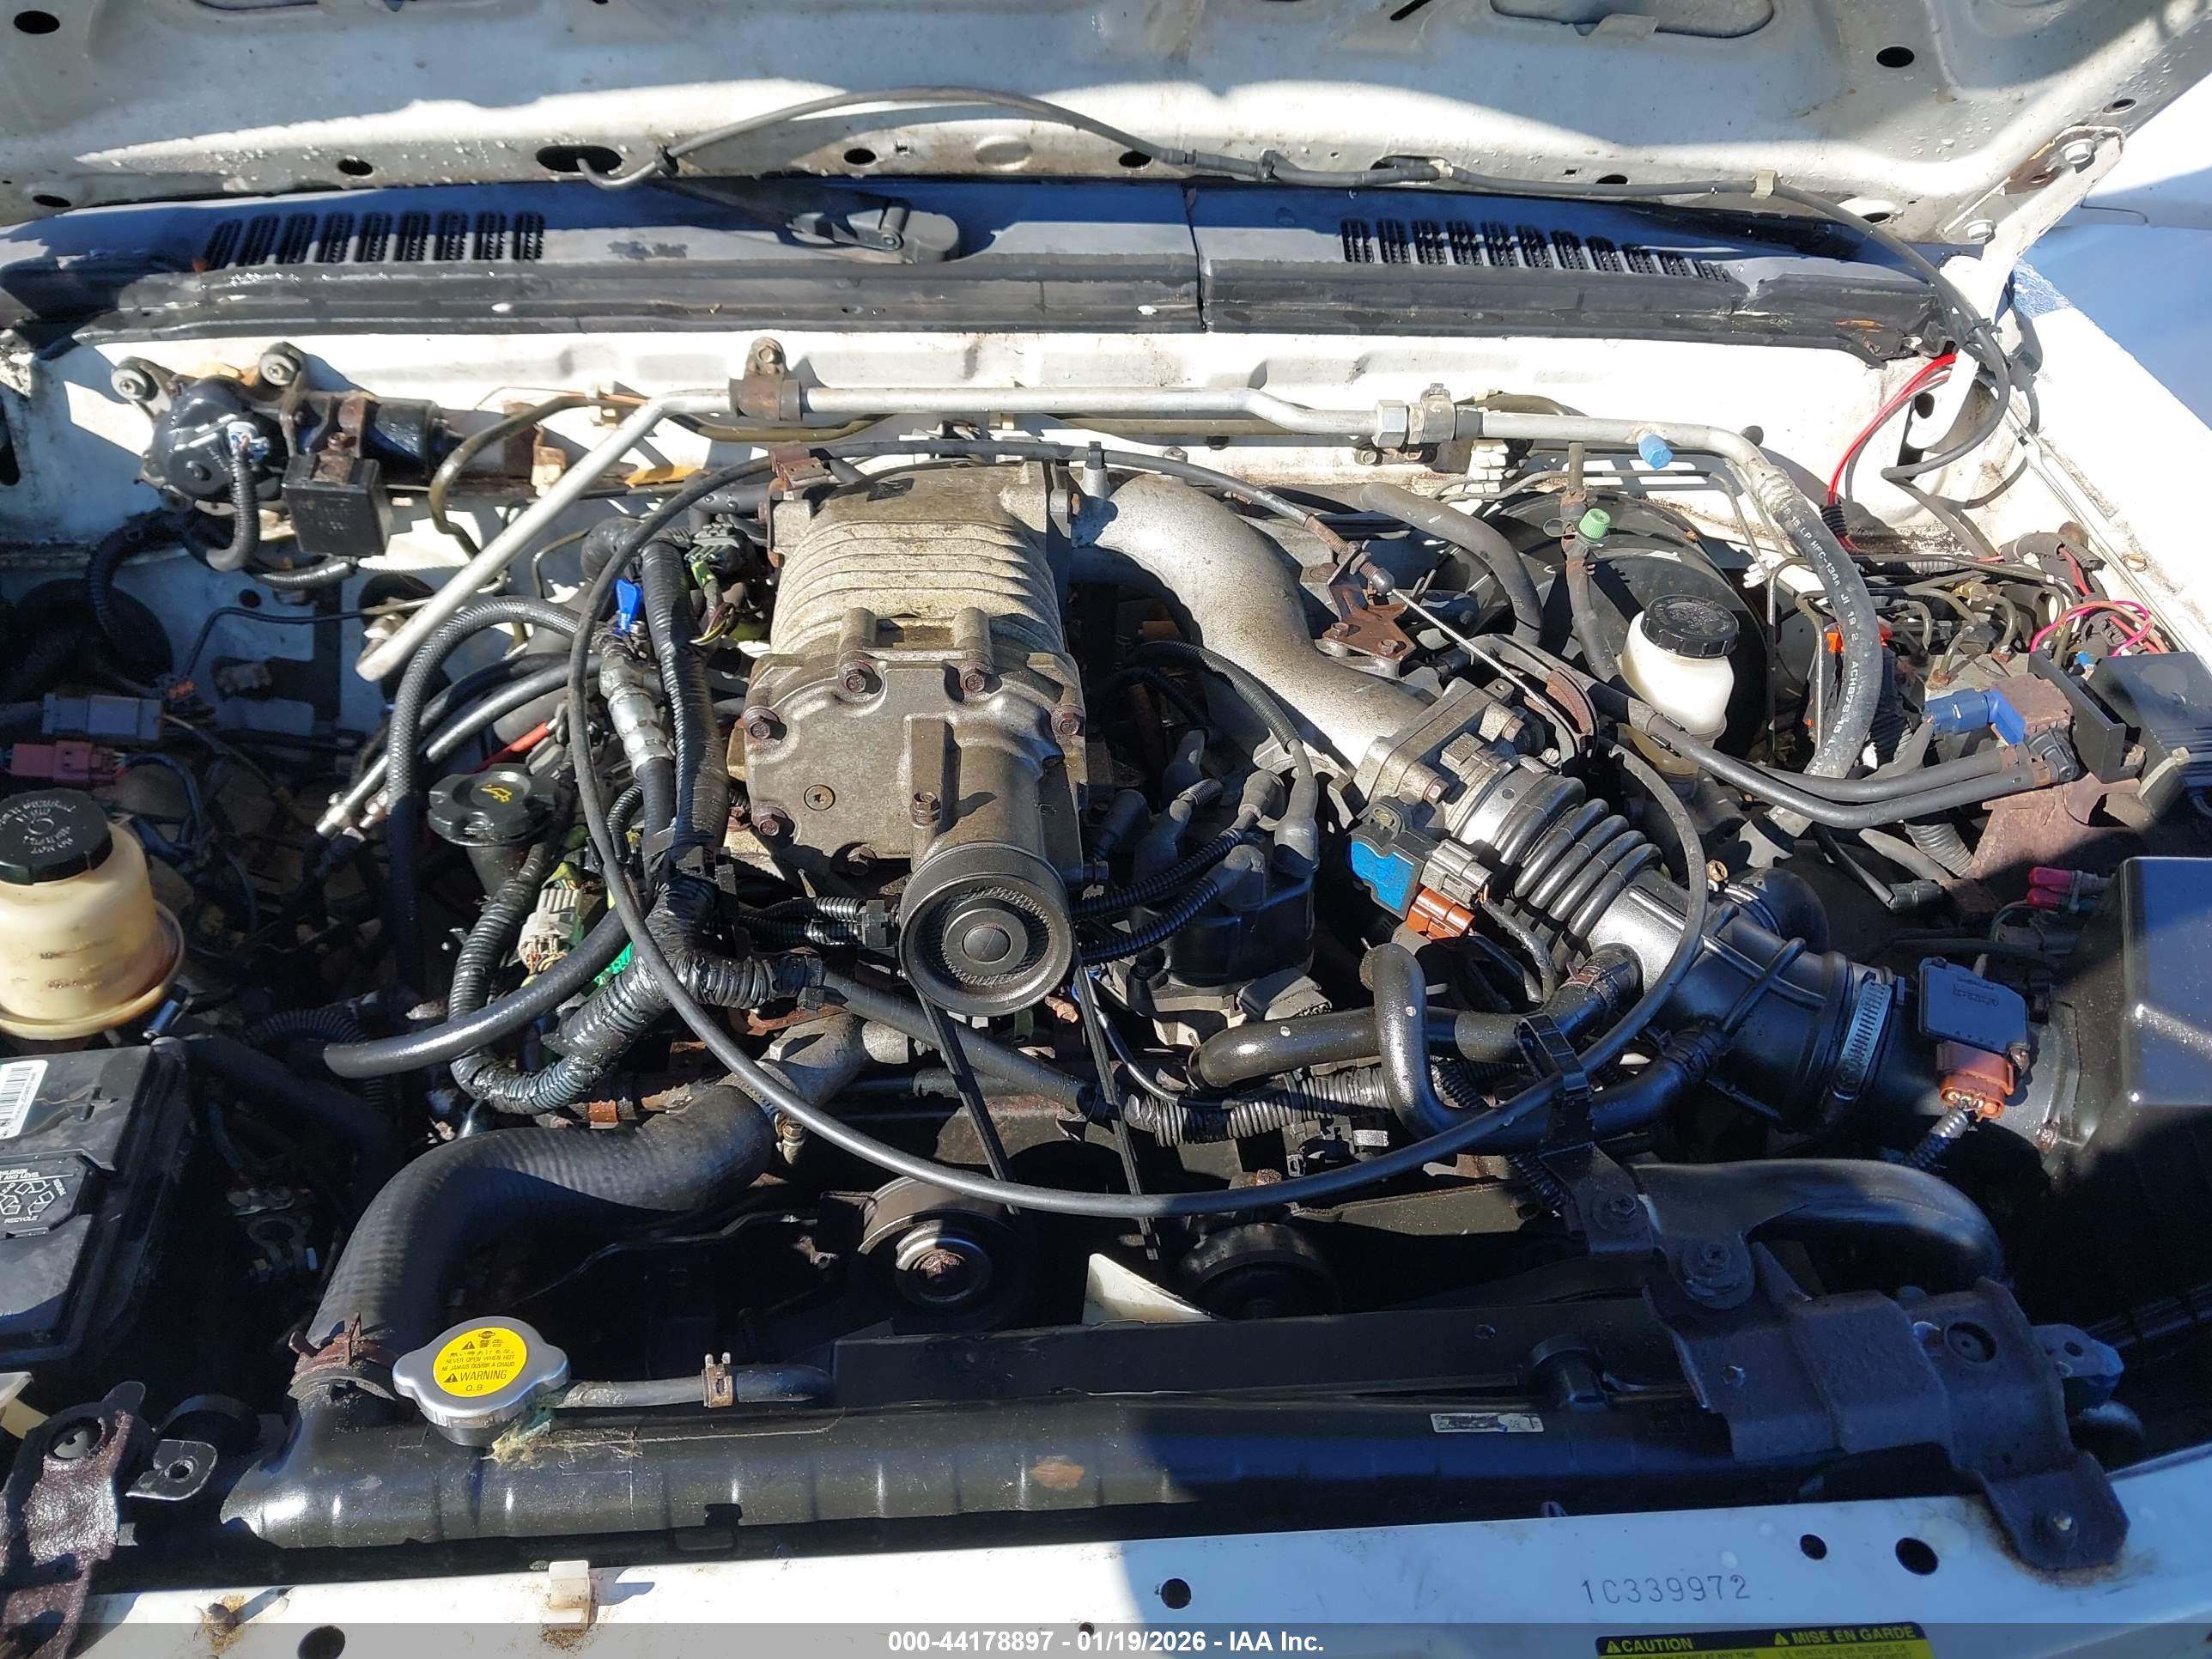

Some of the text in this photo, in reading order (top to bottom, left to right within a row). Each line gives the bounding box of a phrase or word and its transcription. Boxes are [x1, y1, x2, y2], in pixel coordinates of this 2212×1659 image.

[1800, 527, 1813, 541] LP
[1810, 540, 1840, 586] HFC-134a
[460, 1369, 508, 1382] WARNING
[1582, 1574, 1750, 1604] 1C339972
[1791, 1625, 1917, 1644] MISE EN GARDE
[1621, 1637, 1695, 1653] CAUTION
